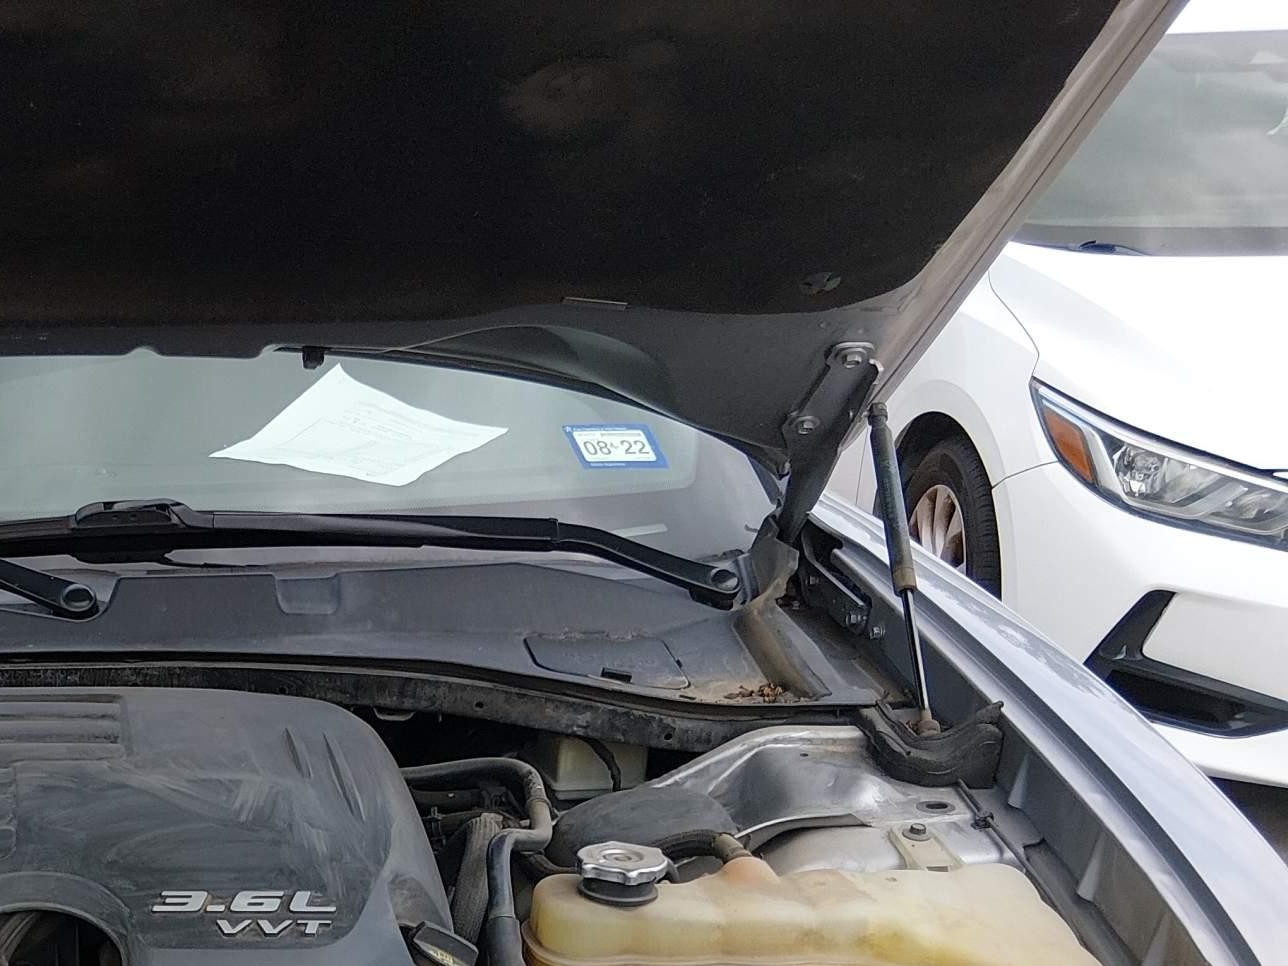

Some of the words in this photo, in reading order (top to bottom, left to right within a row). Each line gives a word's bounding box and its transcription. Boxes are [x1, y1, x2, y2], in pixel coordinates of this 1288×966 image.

[583, 440, 611, 456] 08
[620, 439, 650, 455] 22
[151, 890, 337, 912] 3.6L
[216, 919, 333, 937] VVT
